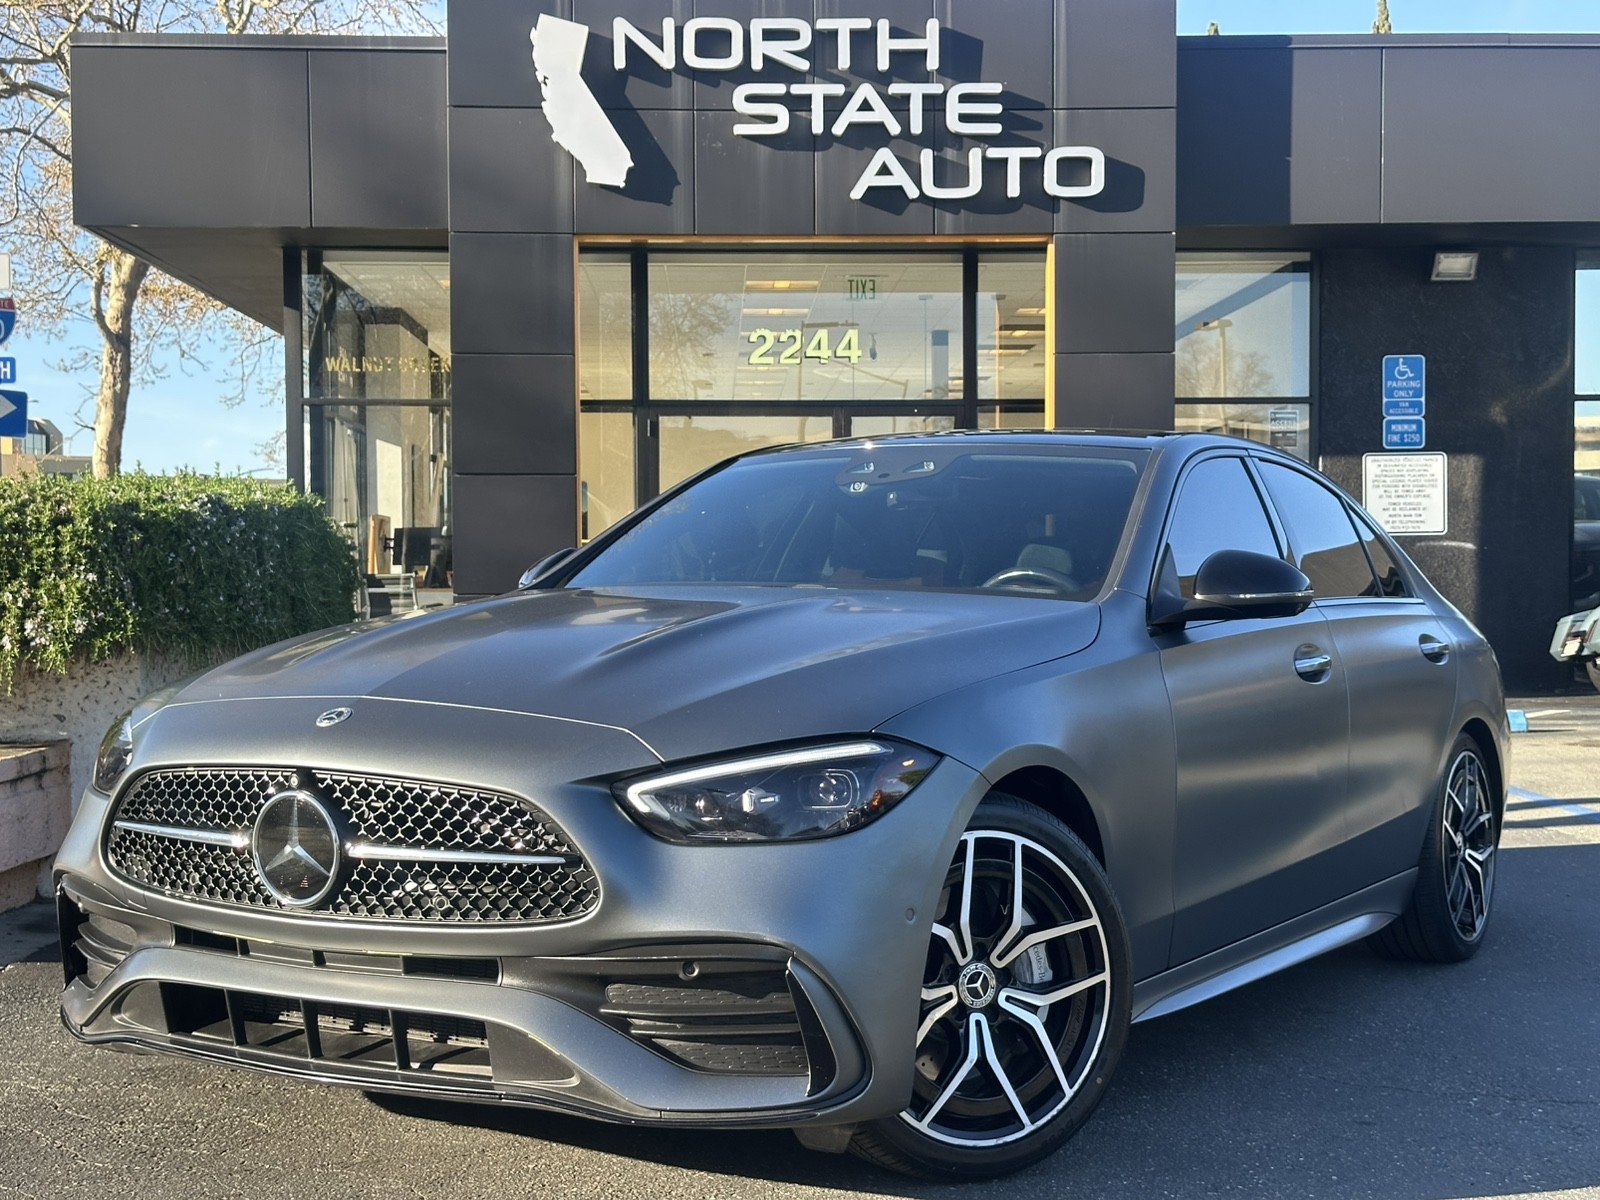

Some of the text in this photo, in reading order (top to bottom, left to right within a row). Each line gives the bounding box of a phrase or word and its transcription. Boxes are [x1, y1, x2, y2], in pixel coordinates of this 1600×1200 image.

[613, 17, 940, 72] NORTH
[733, 82, 1003, 137] STATE
[850, 146, 1105, 200] AUTO
[748, 328, 862, 366] 2244
[1387, 380, 1421, 388] PARKING
[1393, 390, 1414, 398] ONLY
[1387, 433, 1421, 443] FINE $250
[1391, 424, 1417, 432] MINIMUM
[1033, 946, 1046, 982] cedes-B
